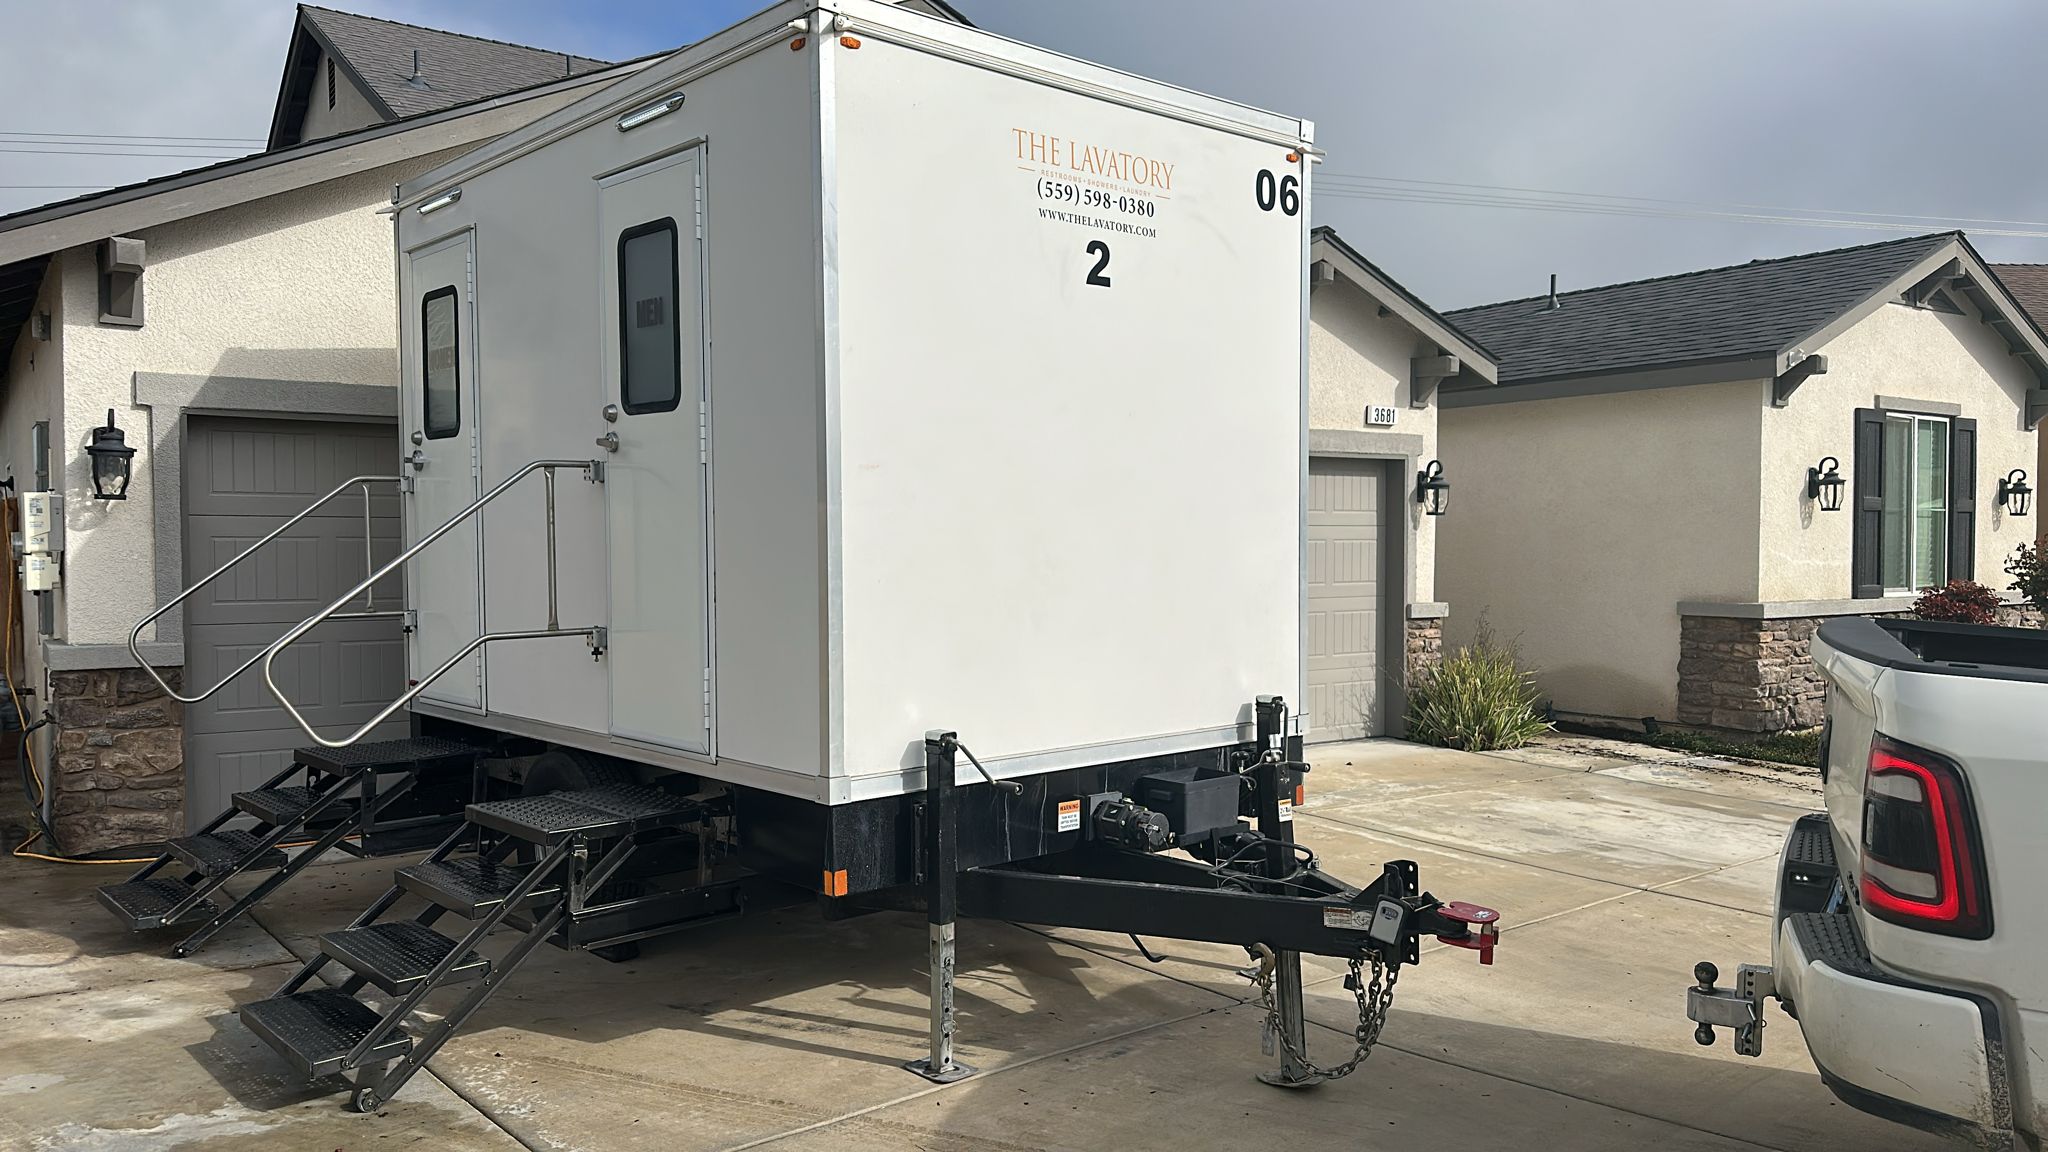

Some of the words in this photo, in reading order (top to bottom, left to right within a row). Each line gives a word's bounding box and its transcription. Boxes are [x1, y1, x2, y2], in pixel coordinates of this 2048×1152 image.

[1012, 127, 1060, 166] THE
[1069, 141, 1175, 190] LAVATORY
[1037, 177, 1080, 206] (559)
[1084, 189, 1155, 218] 598-0380
[1040, 169, 1082, 183] RESTROOMS
[1087, 180, 1118, 191] SHOWERS
[1123, 186, 1151, 197] LAUNDRY
[1255, 168, 1299, 216] 06
[1038, 208, 1156, 238] WWW.THELAVATORY.COM
[1085, 240, 1111, 287] 2
[636, 296, 664, 328] MEN
[1374, 407, 1395, 423] 3681
